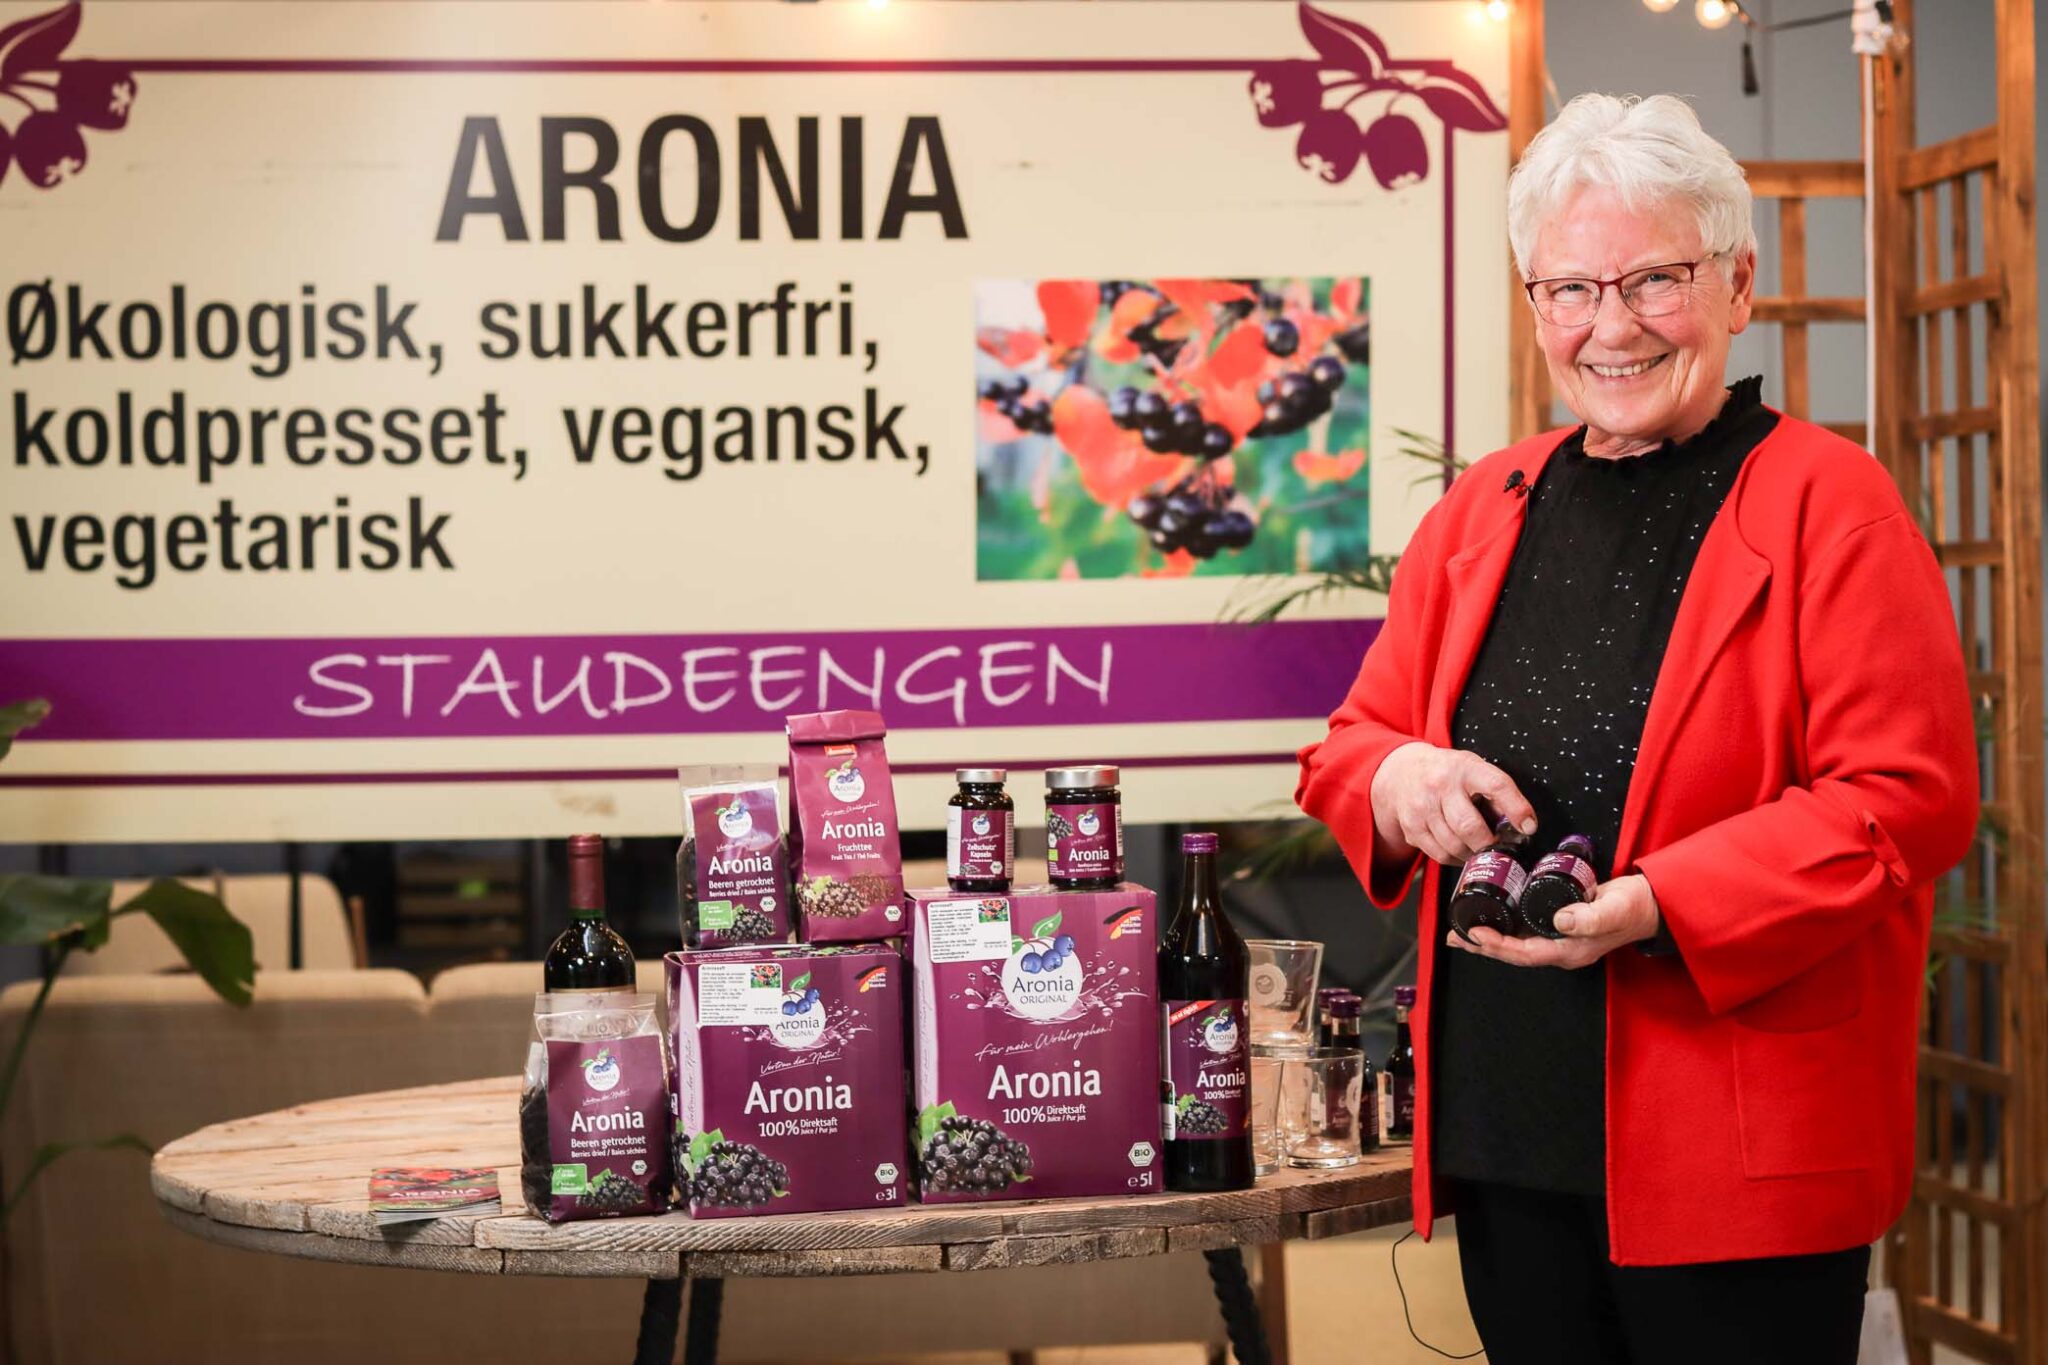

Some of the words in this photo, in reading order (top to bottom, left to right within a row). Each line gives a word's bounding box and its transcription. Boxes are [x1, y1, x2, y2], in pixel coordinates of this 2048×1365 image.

[435, 115, 969, 243] ARONIA
[5, 279, 446, 377] Økologisk,
[478, 283, 880, 372] sukkerfri,
[13, 390, 530, 483] koldpresset,
[563, 388, 932, 481] vegansk,
[13, 498, 455, 590] vegetarisk
[293, 641, 1114, 727] STAUDEENGEN
[821, 817, 886, 841] Aronia
[837, 843, 873, 852] Fruchttee
[1069, 846, 1110, 861] Aronia
[708, 851, 774, 876] Aronia
[709, 879, 735, 890] Beeren
[735, 877, 775, 890] getrocknet
[1012, 975, 1074, 993] Aronia
[1019, 994, 1068, 1005] ORIGINAL
[776, 1017, 819, 1030] Aronia
[1005, 1041, 1034, 1055] mein
[987, 1059, 1102, 1100] Aronia
[1196, 1068, 1246, 1088] Aronia
[744, 1075, 852, 1115] Aronia
[1204, 1090, 1225, 1101] 100%
[571, 1105, 645, 1133] Aronia
[1002, 1106, 1047, 1124] 100%
[1047, 1104, 1087, 1115] Direktsaft
[758, 1120, 800, 1138] 100%
[800, 1117, 838, 1128] Direktsaft
[571, 1138, 600, 1149] Beeren
[601, 1135, 646, 1150] getrocknet
[571, 1150, 591, 1158] Berries
[591, 1149, 607, 1157] dried
[1134, 1148, 1150, 1157] BIO
[880, 1168, 894, 1176] BIO
[388, 1187, 483, 1199] ARONIA
